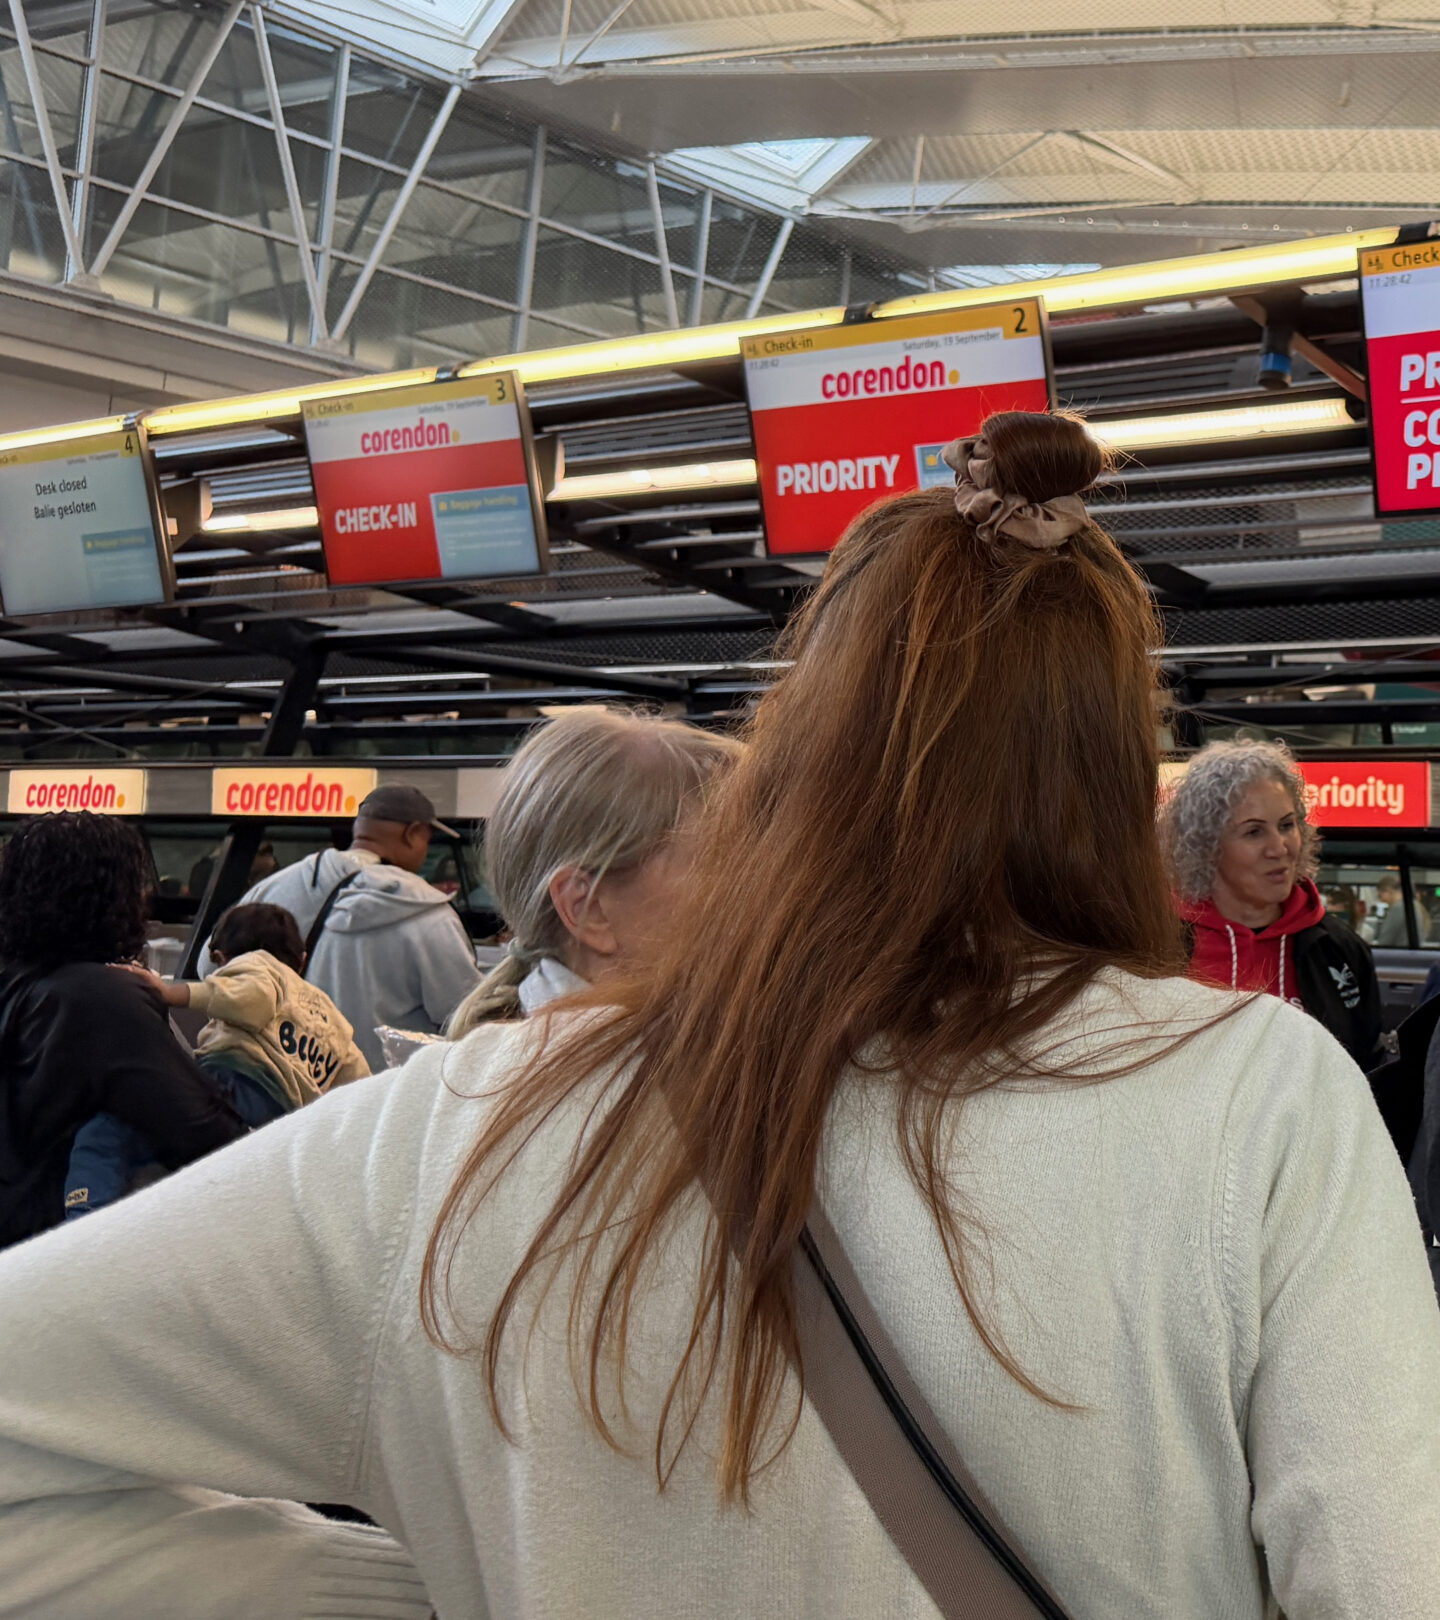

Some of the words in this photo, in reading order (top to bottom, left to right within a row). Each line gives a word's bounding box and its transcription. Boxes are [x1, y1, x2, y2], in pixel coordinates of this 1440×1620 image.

[764, 336, 814, 354] Check-in
[1013, 307, 1028, 334] 2
[496, 379, 506, 402] 3
[124, 434, 134, 454] 4
[35, 481, 57, 496] Desk
[58, 475, 87, 494] closed
[777, 454, 900, 497] PRIORITY
[34, 503, 56, 519] Balie
[57, 501, 97, 520] gesloten
[334, 502, 418, 534] CHECK-IN
